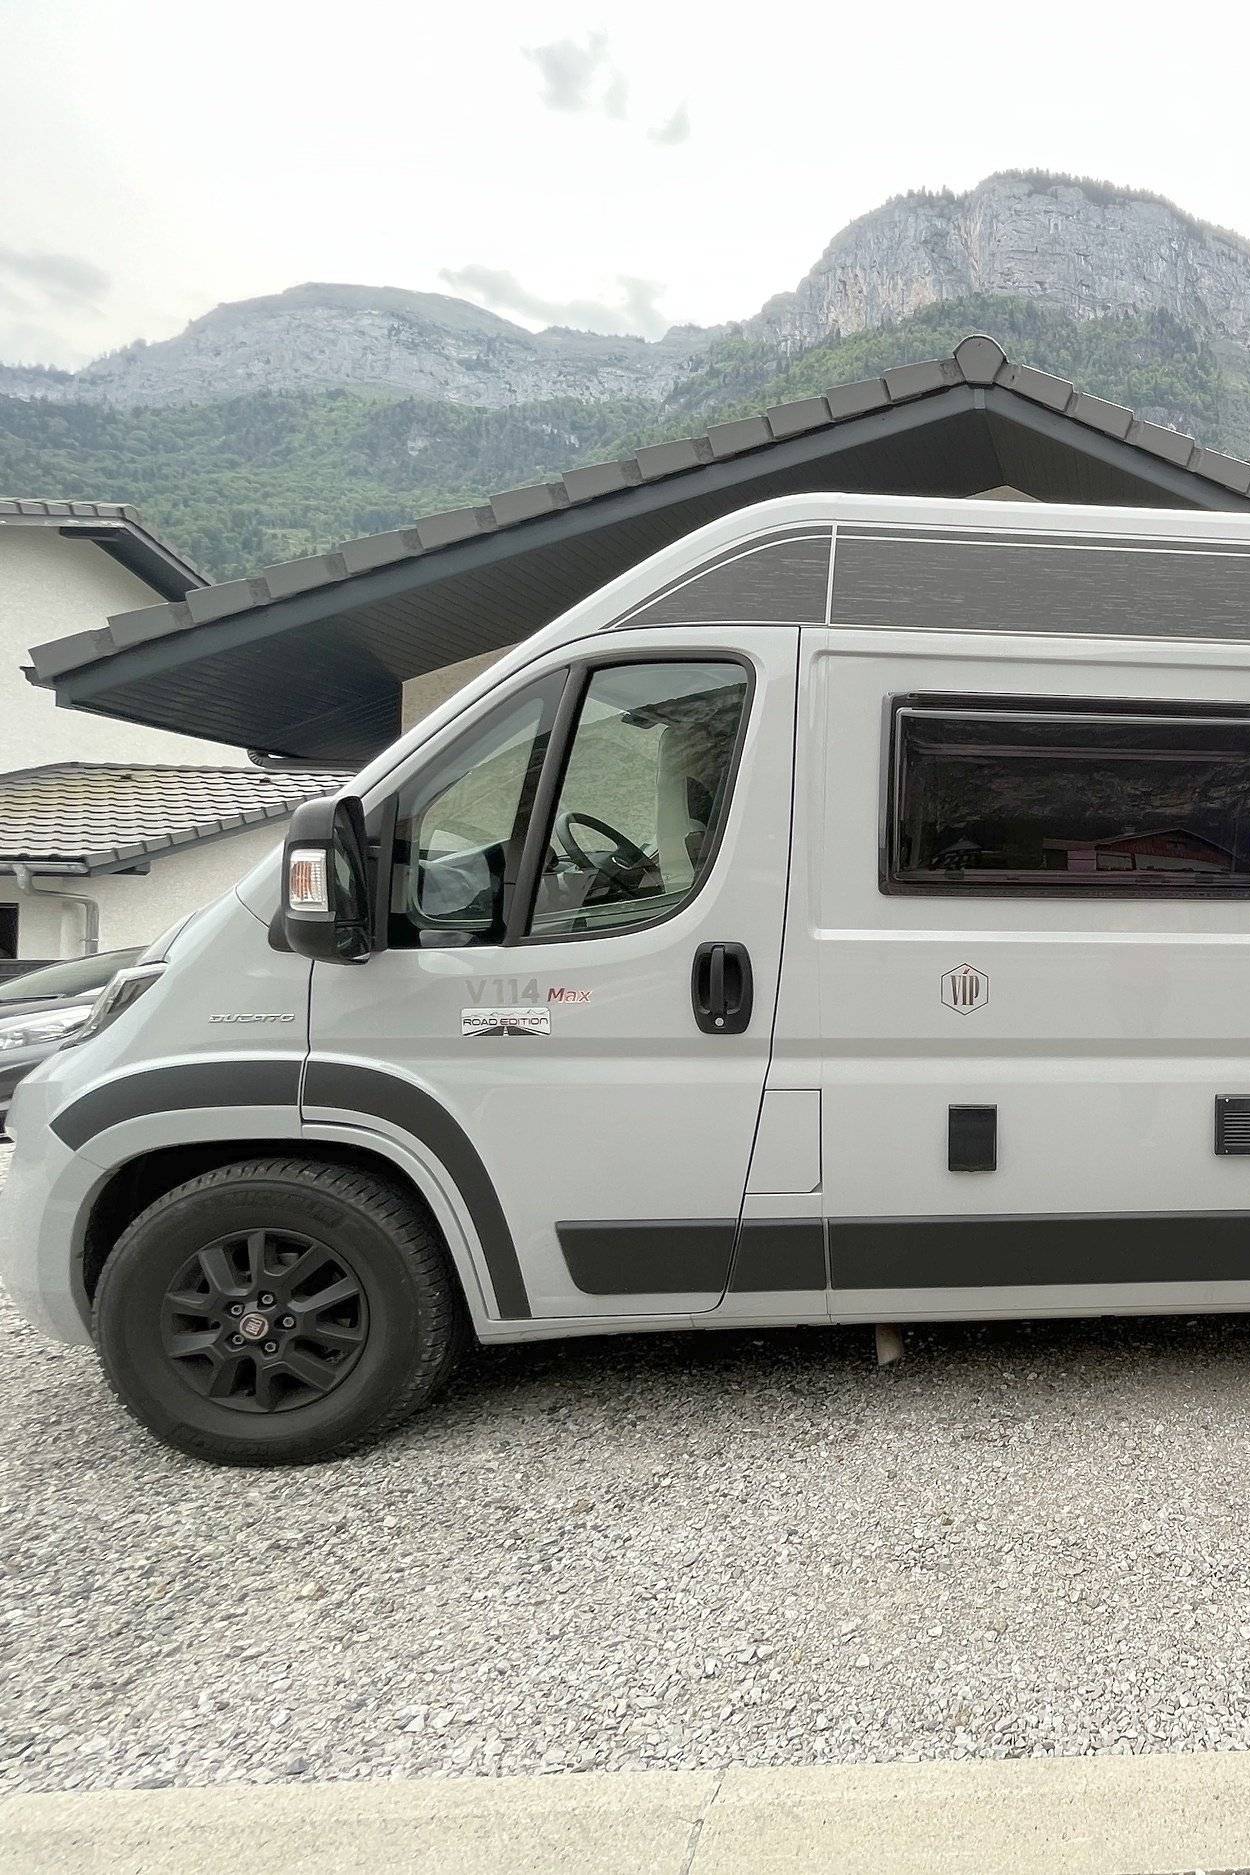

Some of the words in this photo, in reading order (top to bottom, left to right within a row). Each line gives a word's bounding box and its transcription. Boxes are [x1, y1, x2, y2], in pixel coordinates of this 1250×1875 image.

[547, 987, 591, 1003] Max
[208, 1012, 295, 1023] DUCATO
[462, 1017, 498, 1026] ROAD
[500, 1016, 549, 1026] EDITION
